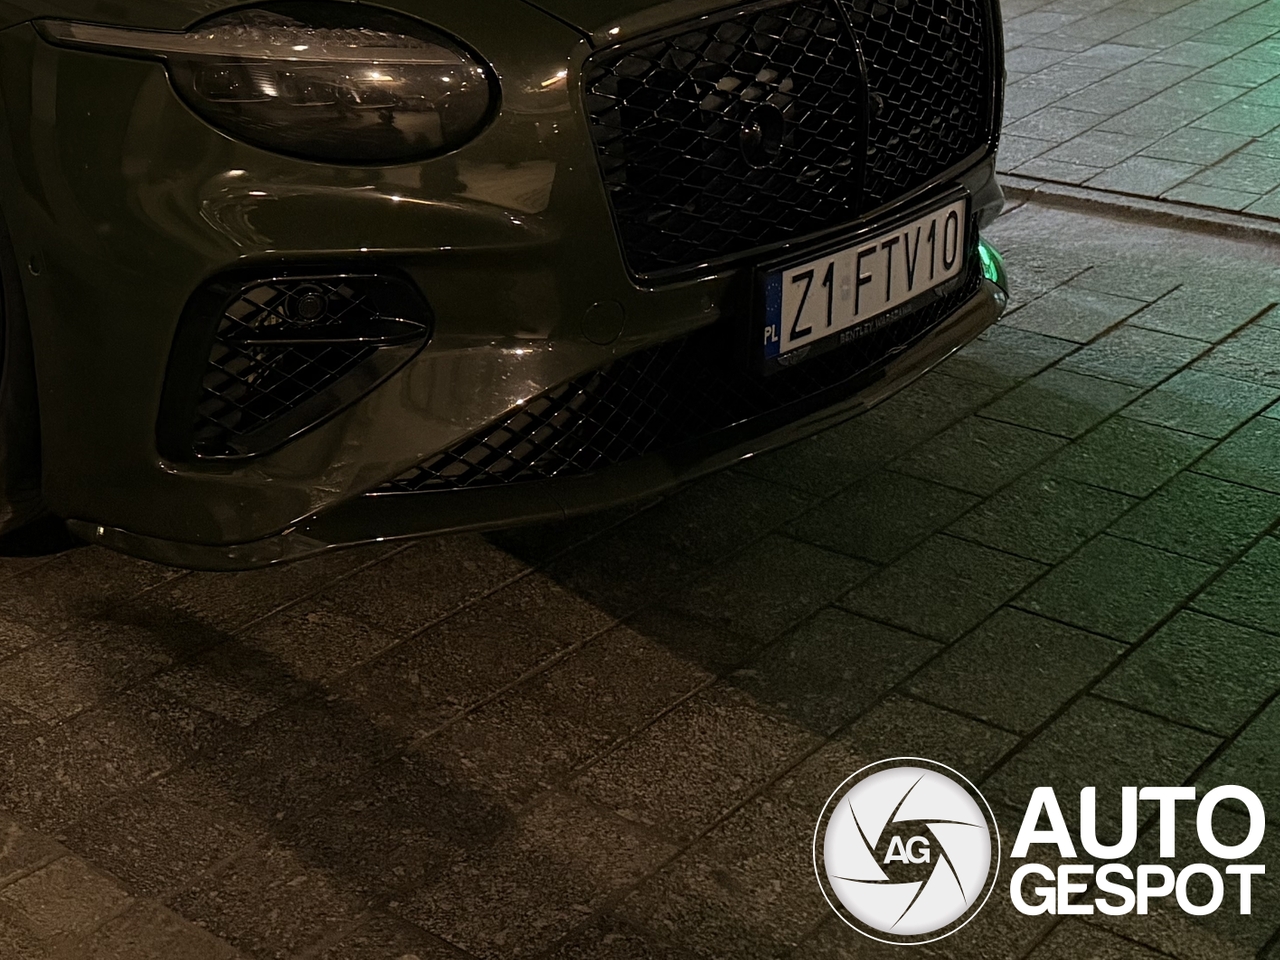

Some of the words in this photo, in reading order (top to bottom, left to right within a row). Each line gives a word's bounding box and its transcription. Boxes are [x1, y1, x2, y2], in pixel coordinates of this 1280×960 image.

[789, 259, 835, 342] Z1
[853, 210, 958, 317] FTV10
[764, 324, 779, 345] PL
